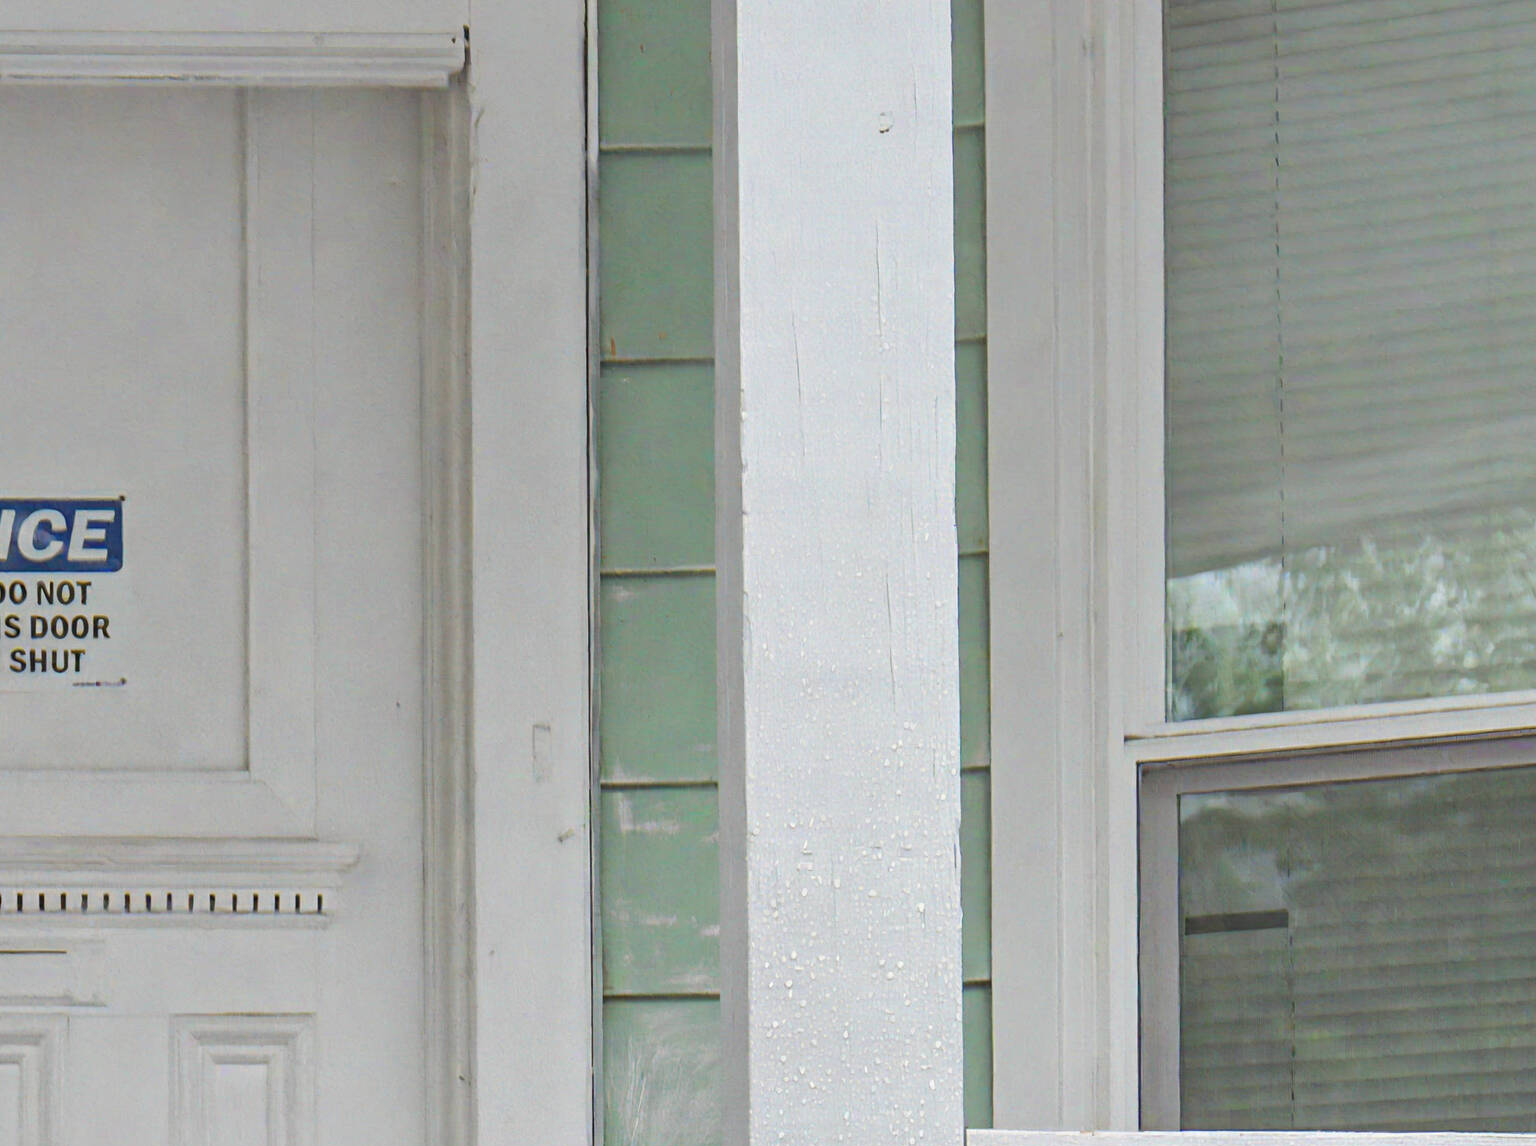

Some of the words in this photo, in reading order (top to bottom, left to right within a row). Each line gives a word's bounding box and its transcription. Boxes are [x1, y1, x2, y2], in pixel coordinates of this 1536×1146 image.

[36, 579, 92, 605] NOT
[30, 614, 111, 639] DOOR
[9, 647, 87, 673] SHUT
